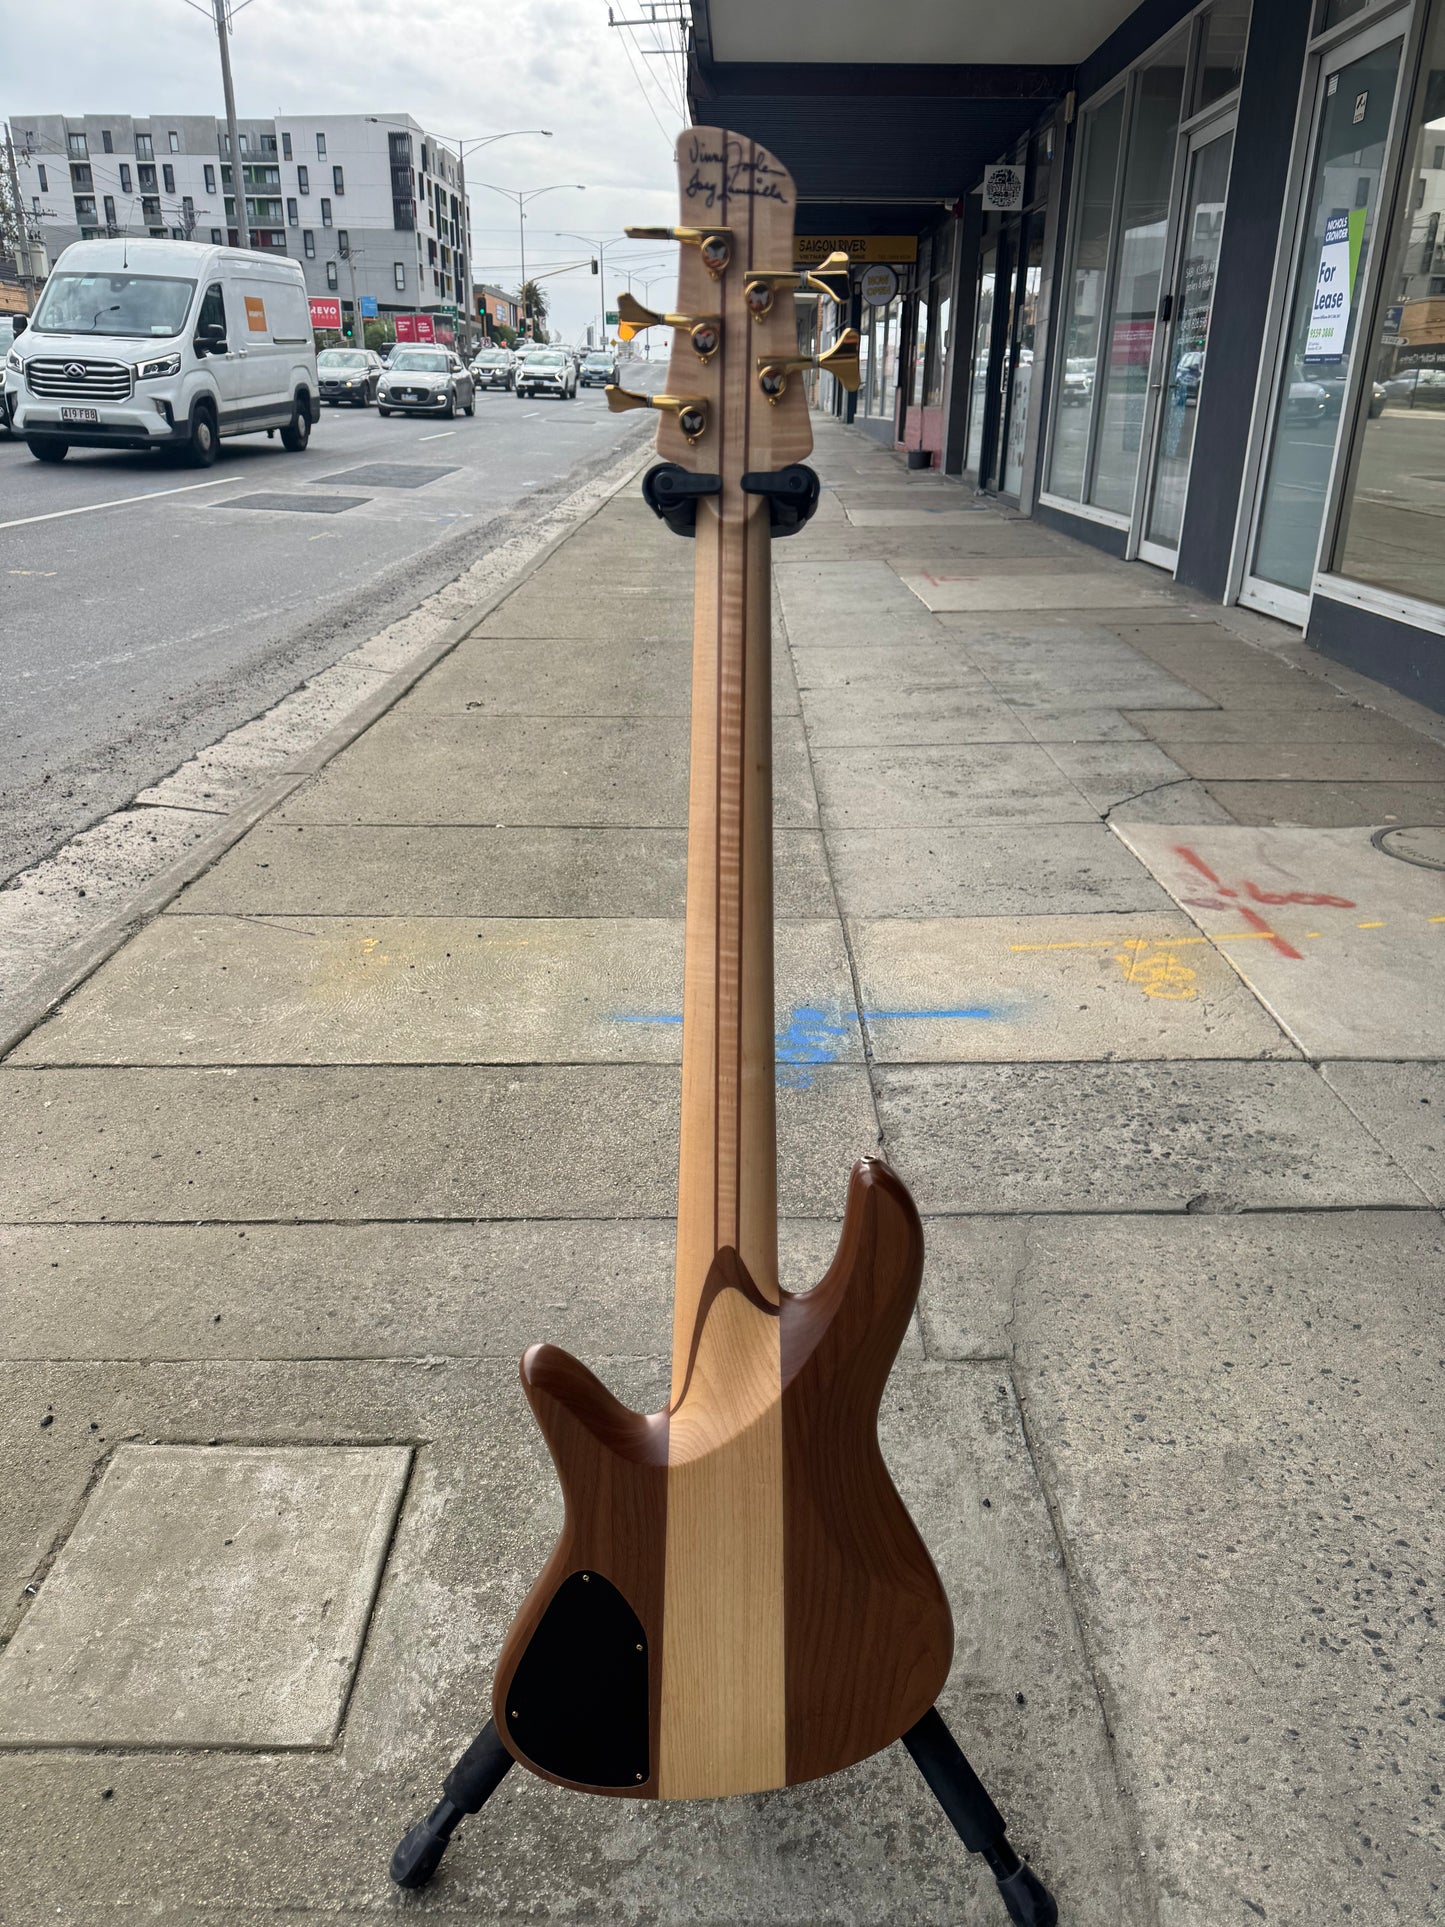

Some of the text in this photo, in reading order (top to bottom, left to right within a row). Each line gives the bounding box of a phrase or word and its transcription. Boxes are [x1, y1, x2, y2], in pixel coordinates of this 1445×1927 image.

[1326, 217, 1348, 230] NICHOLS
[1325, 228, 1348, 242] CROWDER
[799, 239, 867, 252] SAIGON RIVER
[1319, 261, 1337, 283] For
[867, 286, 891, 297] OPEN
[1314, 289, 1344, 310] Lease
[311, 305, 337, 315] REVO
